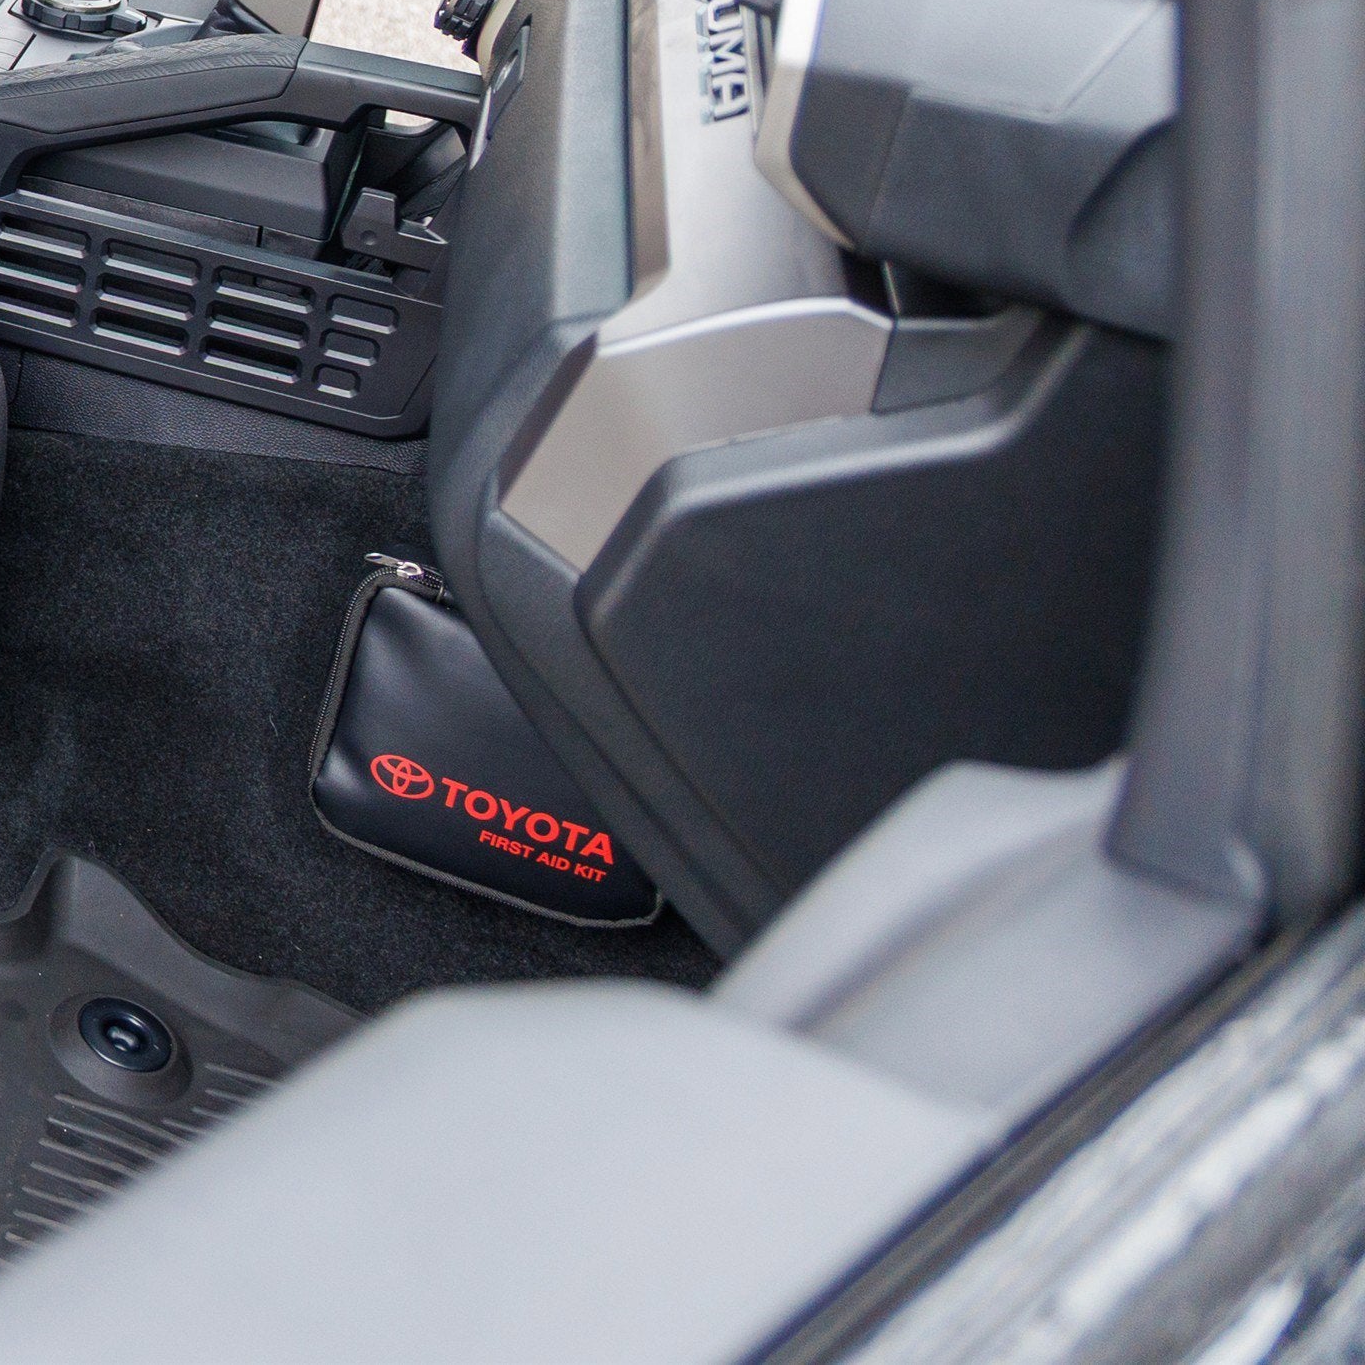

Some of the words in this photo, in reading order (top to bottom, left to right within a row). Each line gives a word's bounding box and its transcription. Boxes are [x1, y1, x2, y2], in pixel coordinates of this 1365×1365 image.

[441, 777, 614, 865] TOYOTA
[479, 830, 535, 859] FIRST
[536, 852, 570, 871] AID
[574, 863, 606, 882] KIT
